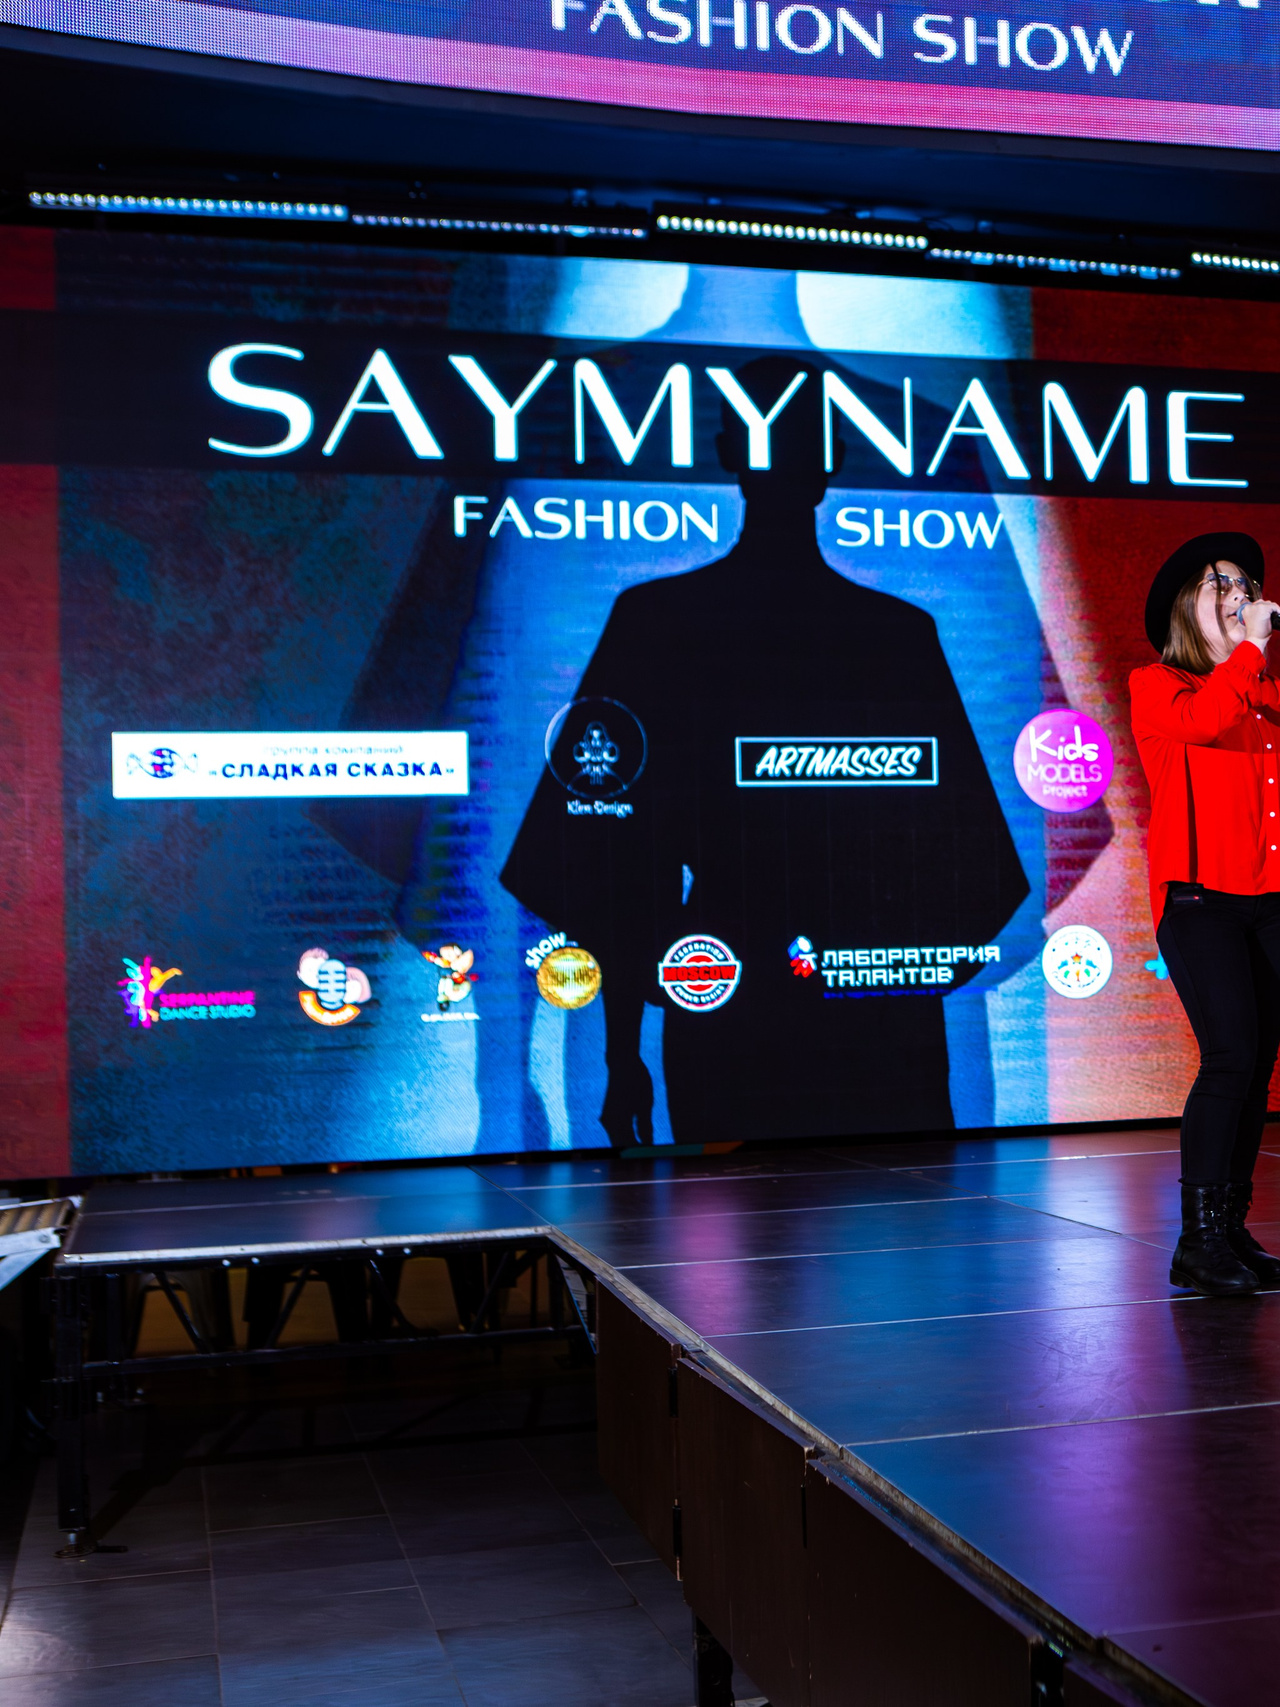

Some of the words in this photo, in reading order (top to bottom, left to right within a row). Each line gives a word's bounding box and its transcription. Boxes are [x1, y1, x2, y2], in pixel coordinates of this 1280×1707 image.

[551, 0, 884, 58] FASHION
[913, 14, 1133, 75] SHOW
[207, 342, 1249, 489] SAYMYNAME
[454, 495, 719, 543] FASHION
[835, 506, 1003, 549] SHOW
[1028, 725, 1099, 763] Kids
[755, 745, 922, 778] ARTMASSES
[1027, 763, 1102, 783] MODELS
[821, 945, 1000, 968] ЛАБОРАТОРИЯ
[662, 965, 736, 982] MOSCOW
[821, 966, 954, 987] ТАЛАНТОВ
[159, 1006, 208, 1020] DANCE
[208, 1004, 257, 1019] STUDIO
